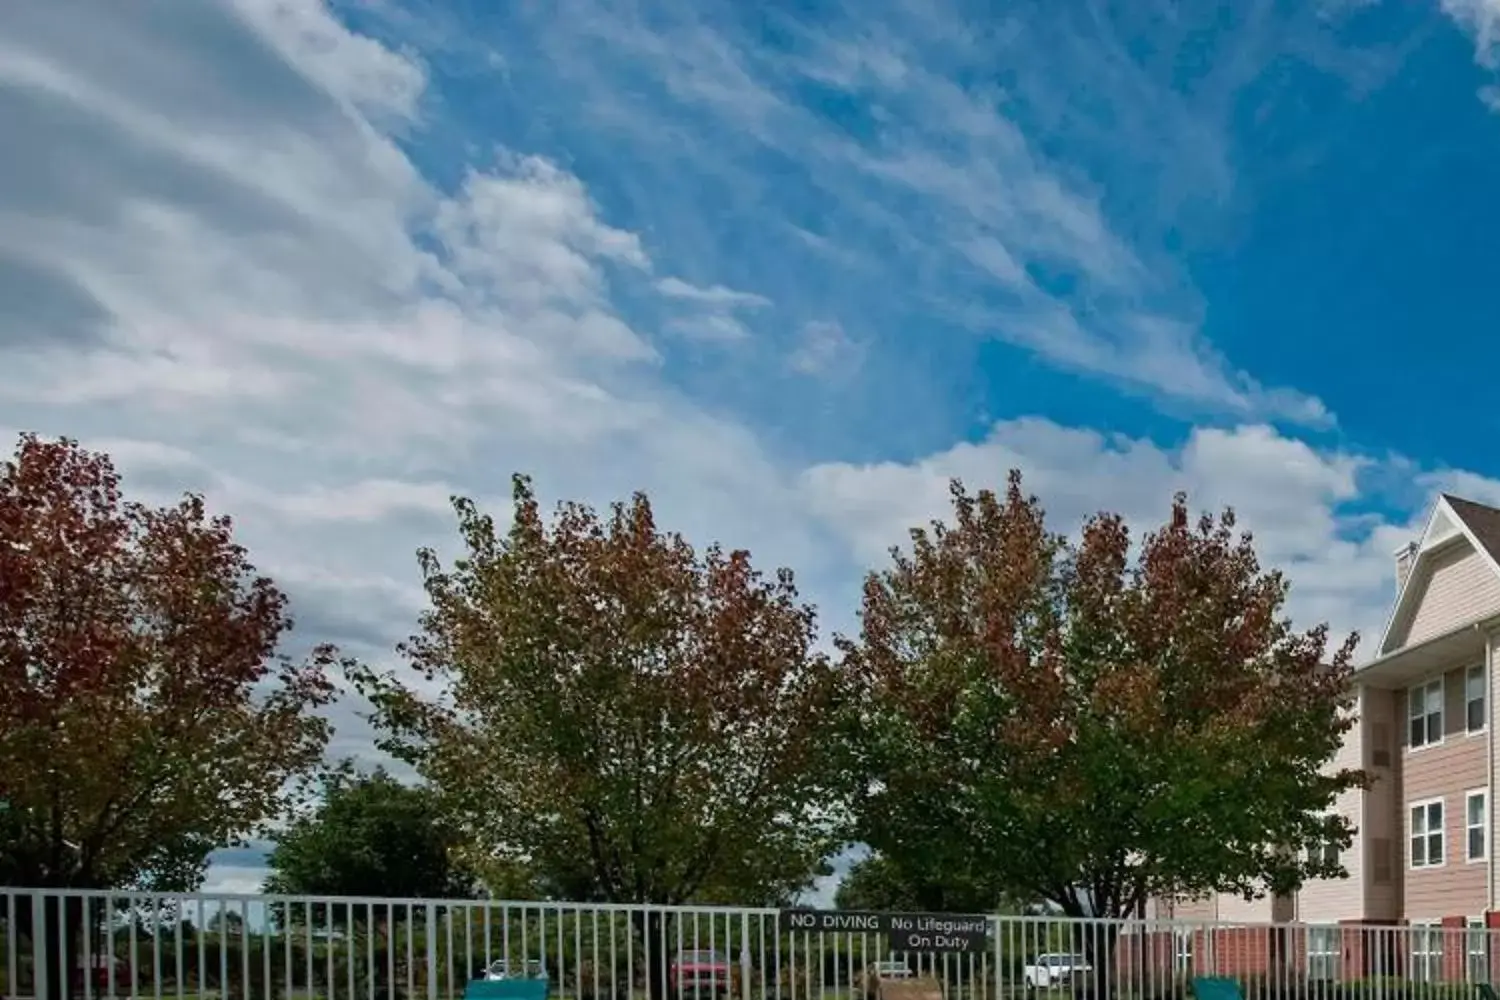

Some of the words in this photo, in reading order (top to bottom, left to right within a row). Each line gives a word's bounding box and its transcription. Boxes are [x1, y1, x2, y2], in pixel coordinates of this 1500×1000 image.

[791, 914, 817, 927] NO
[823, 915, 879, 929] DIVING
[891, 917, 913, 930] No
[917, 916, 985, 935] Lifeguard
[908, 934, 931, 947] On
[935, 935, 969, 951] Duty
